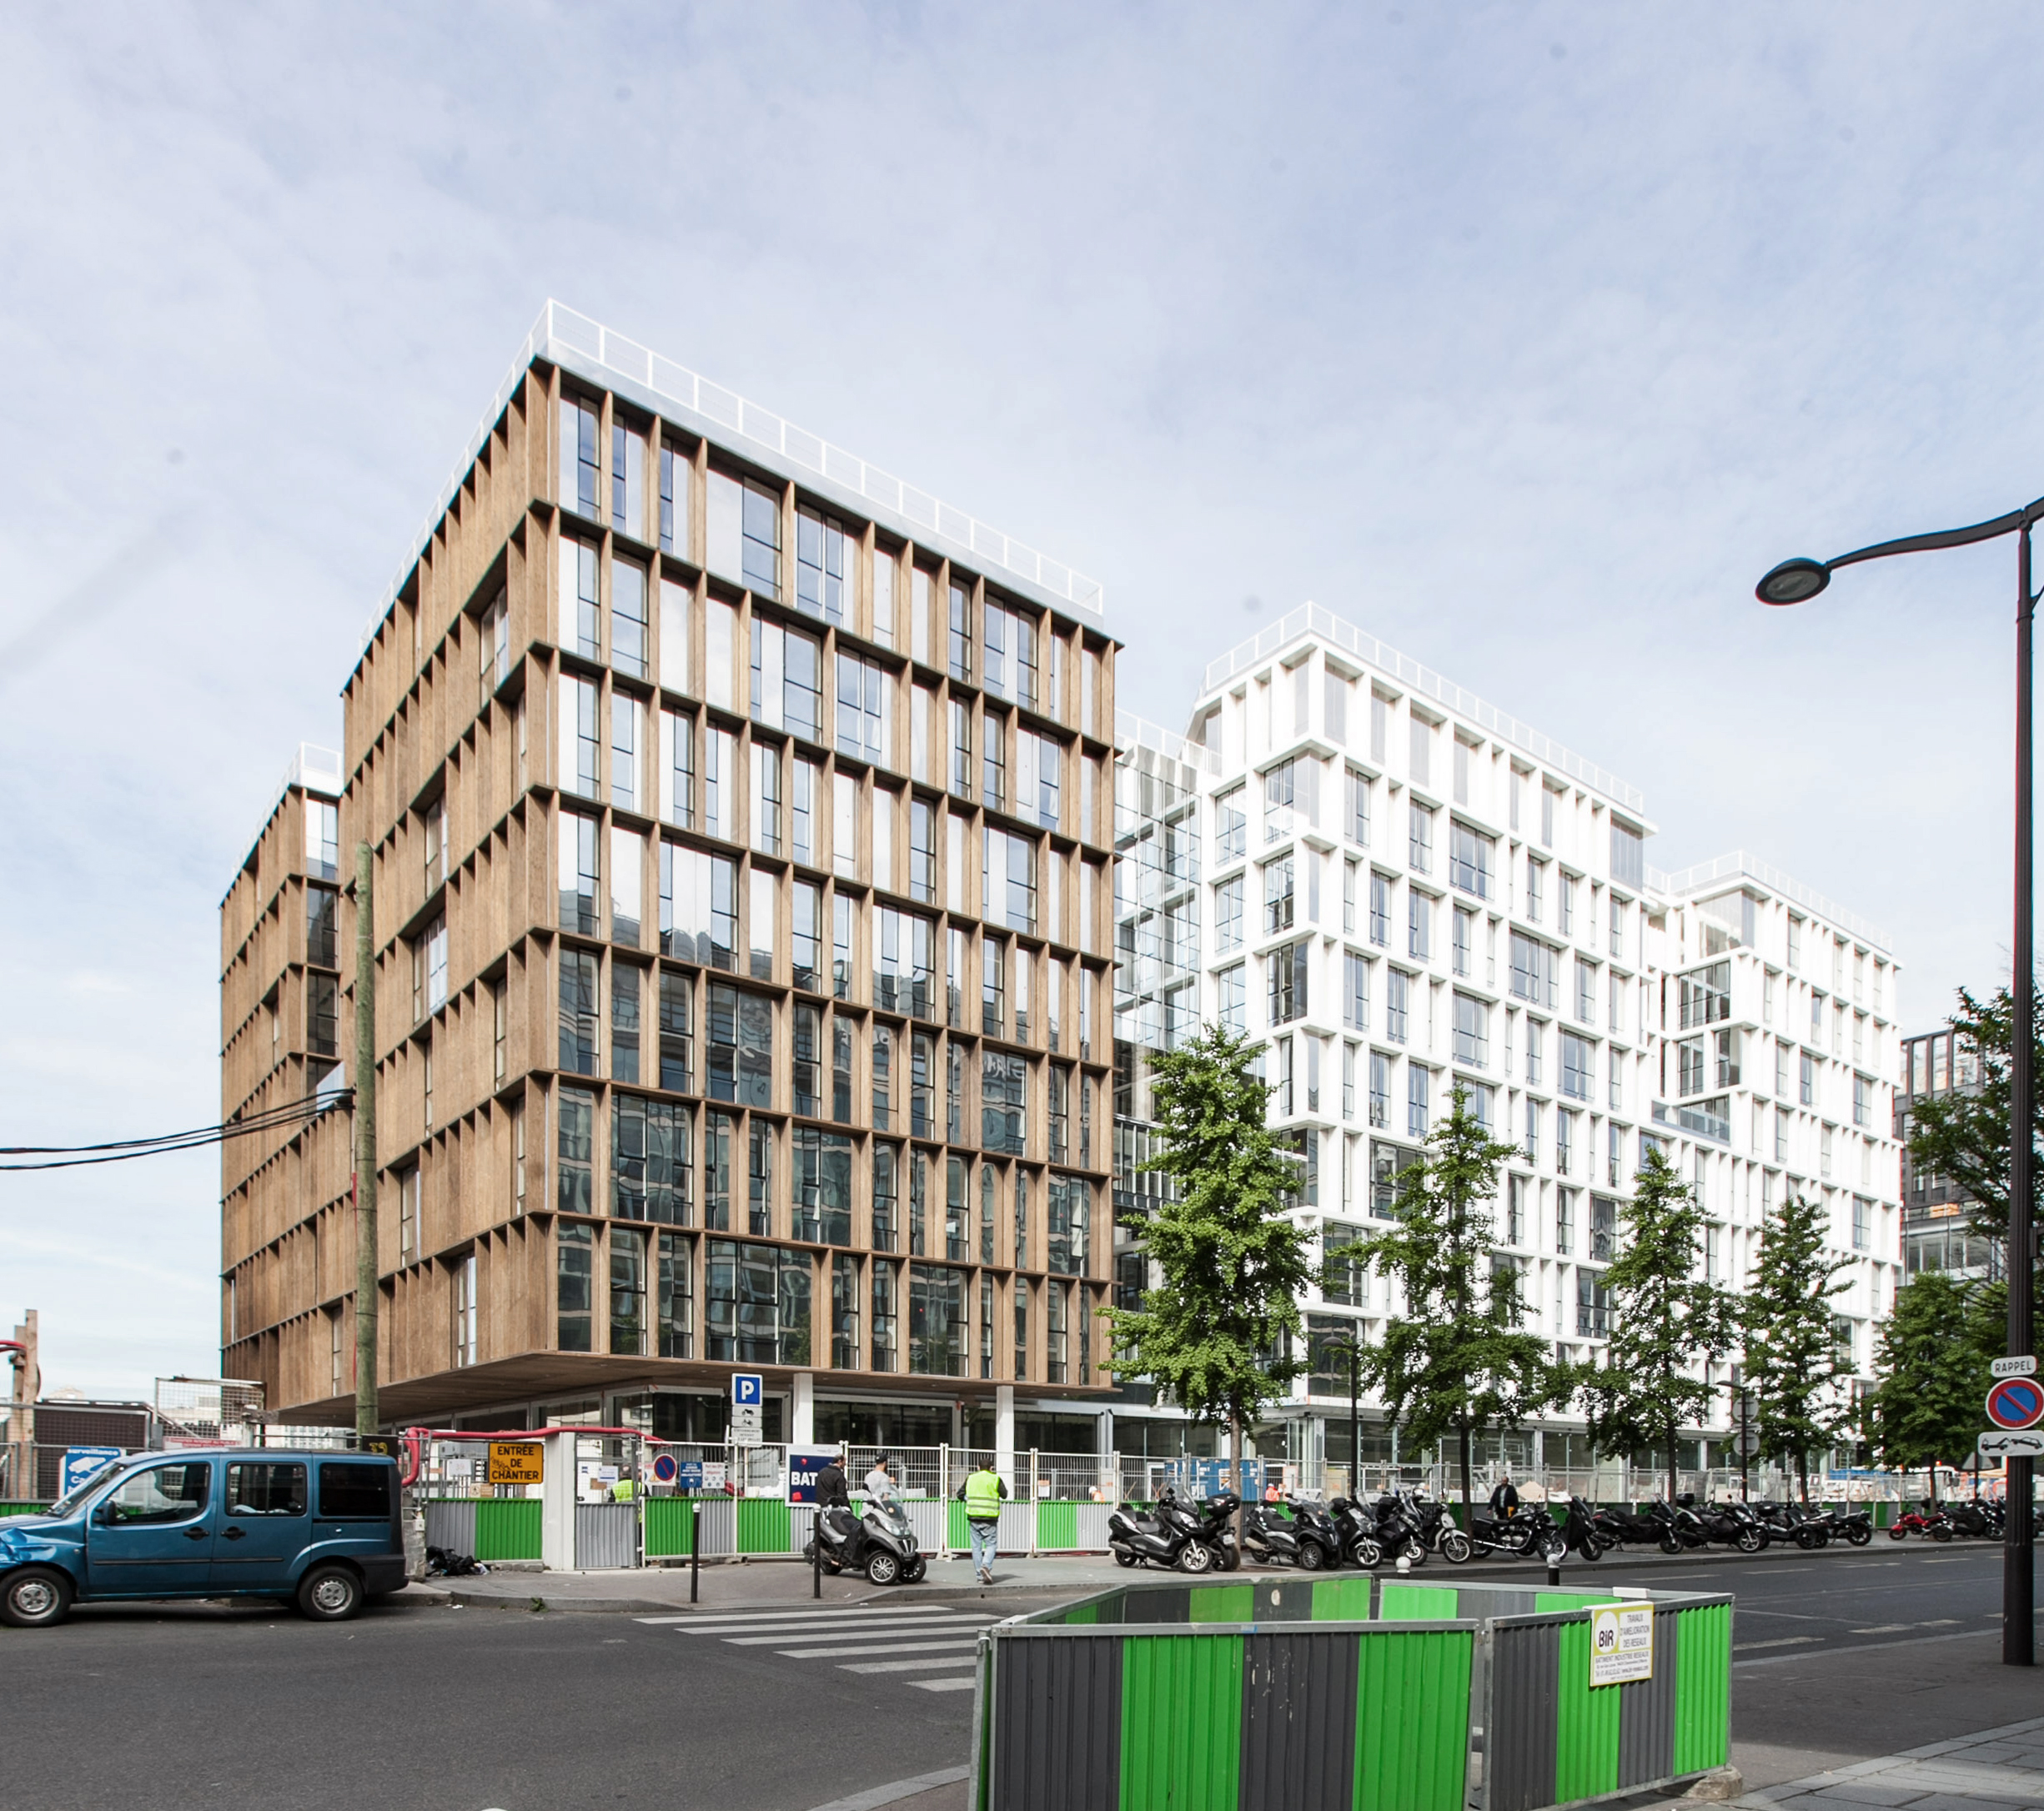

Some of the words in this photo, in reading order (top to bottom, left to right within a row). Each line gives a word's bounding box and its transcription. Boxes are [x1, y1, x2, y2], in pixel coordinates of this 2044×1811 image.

[1995, 1360, 2031, 1372] RAPPEL
[741, 1380, 755, 1401] P
[497, 1443, 535, 1455] ENTRÉE
[510, 1458, 523, 1467] DE
[491, 1470, 539, 1480] CHANTIER
